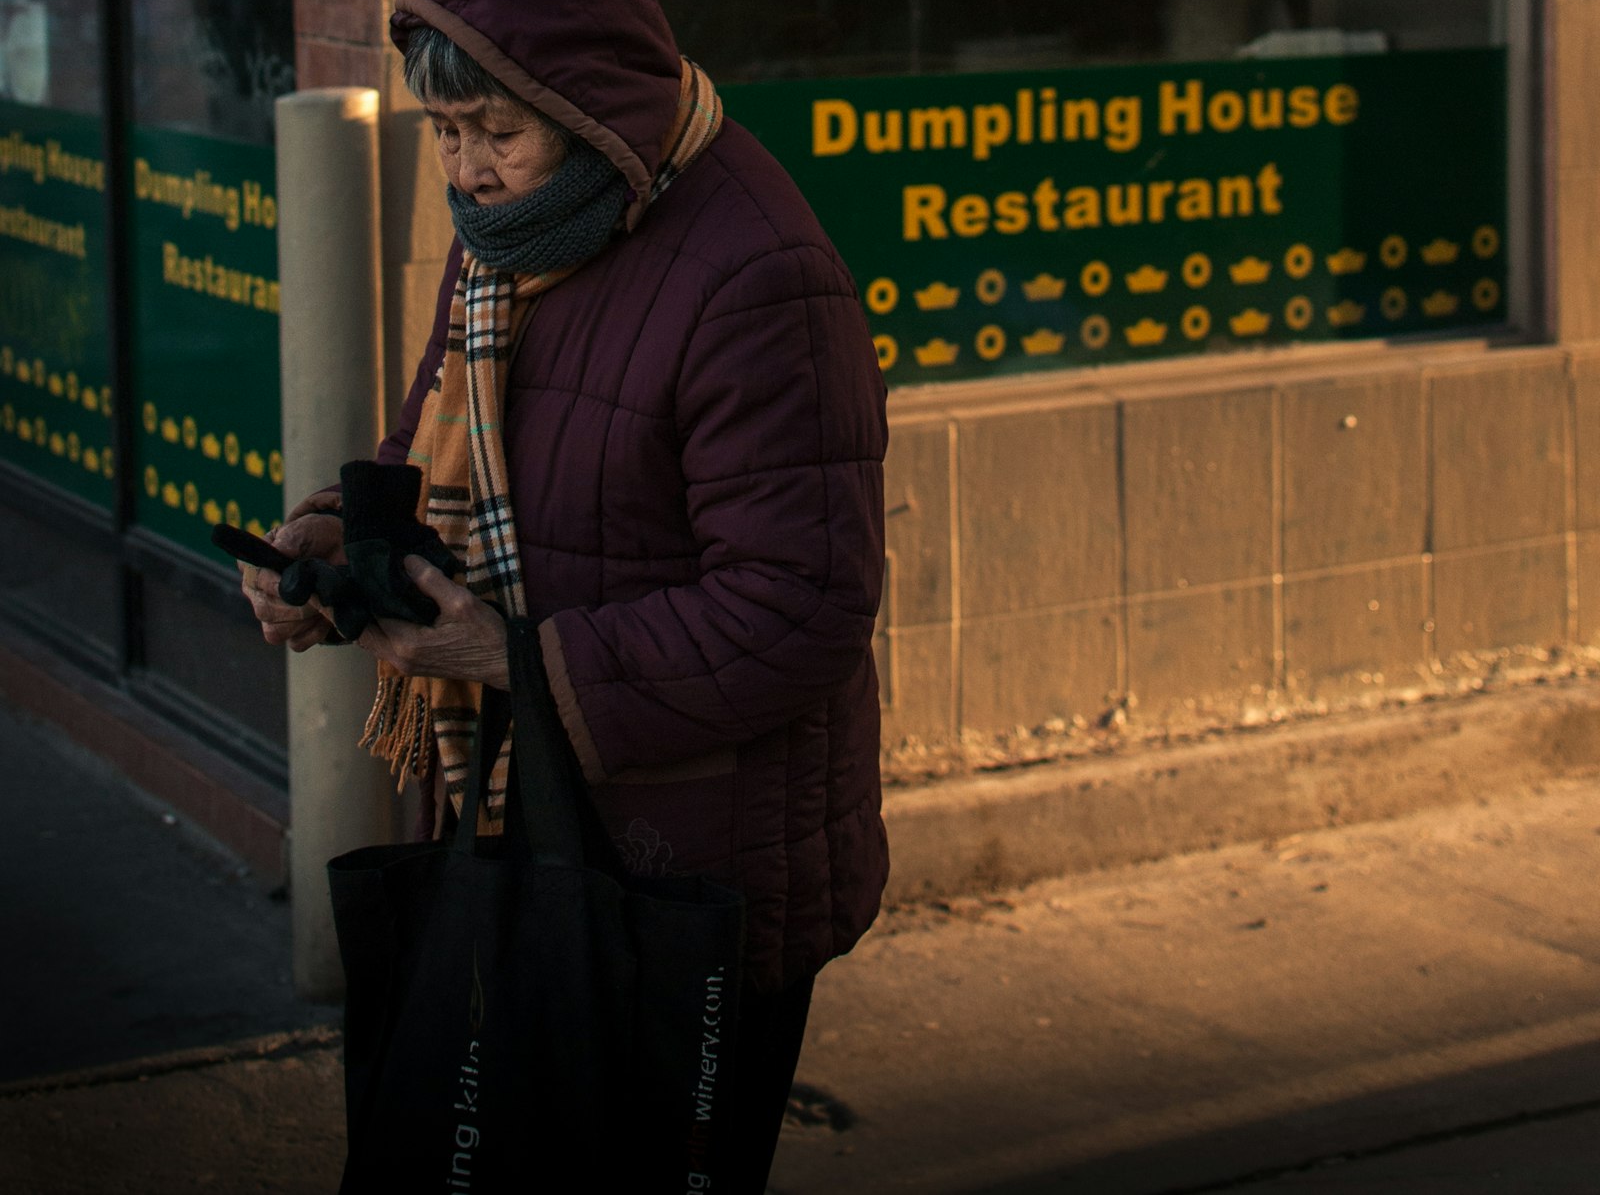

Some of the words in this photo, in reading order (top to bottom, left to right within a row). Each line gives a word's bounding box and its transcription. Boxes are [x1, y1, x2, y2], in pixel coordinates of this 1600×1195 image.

[811, 87, 1142, 161] Dumpling
[1158, 79, 1360, 136] House
[134, 157, 240, 231] Dumpling
[902, 163, 1283, 242] Restaurant
